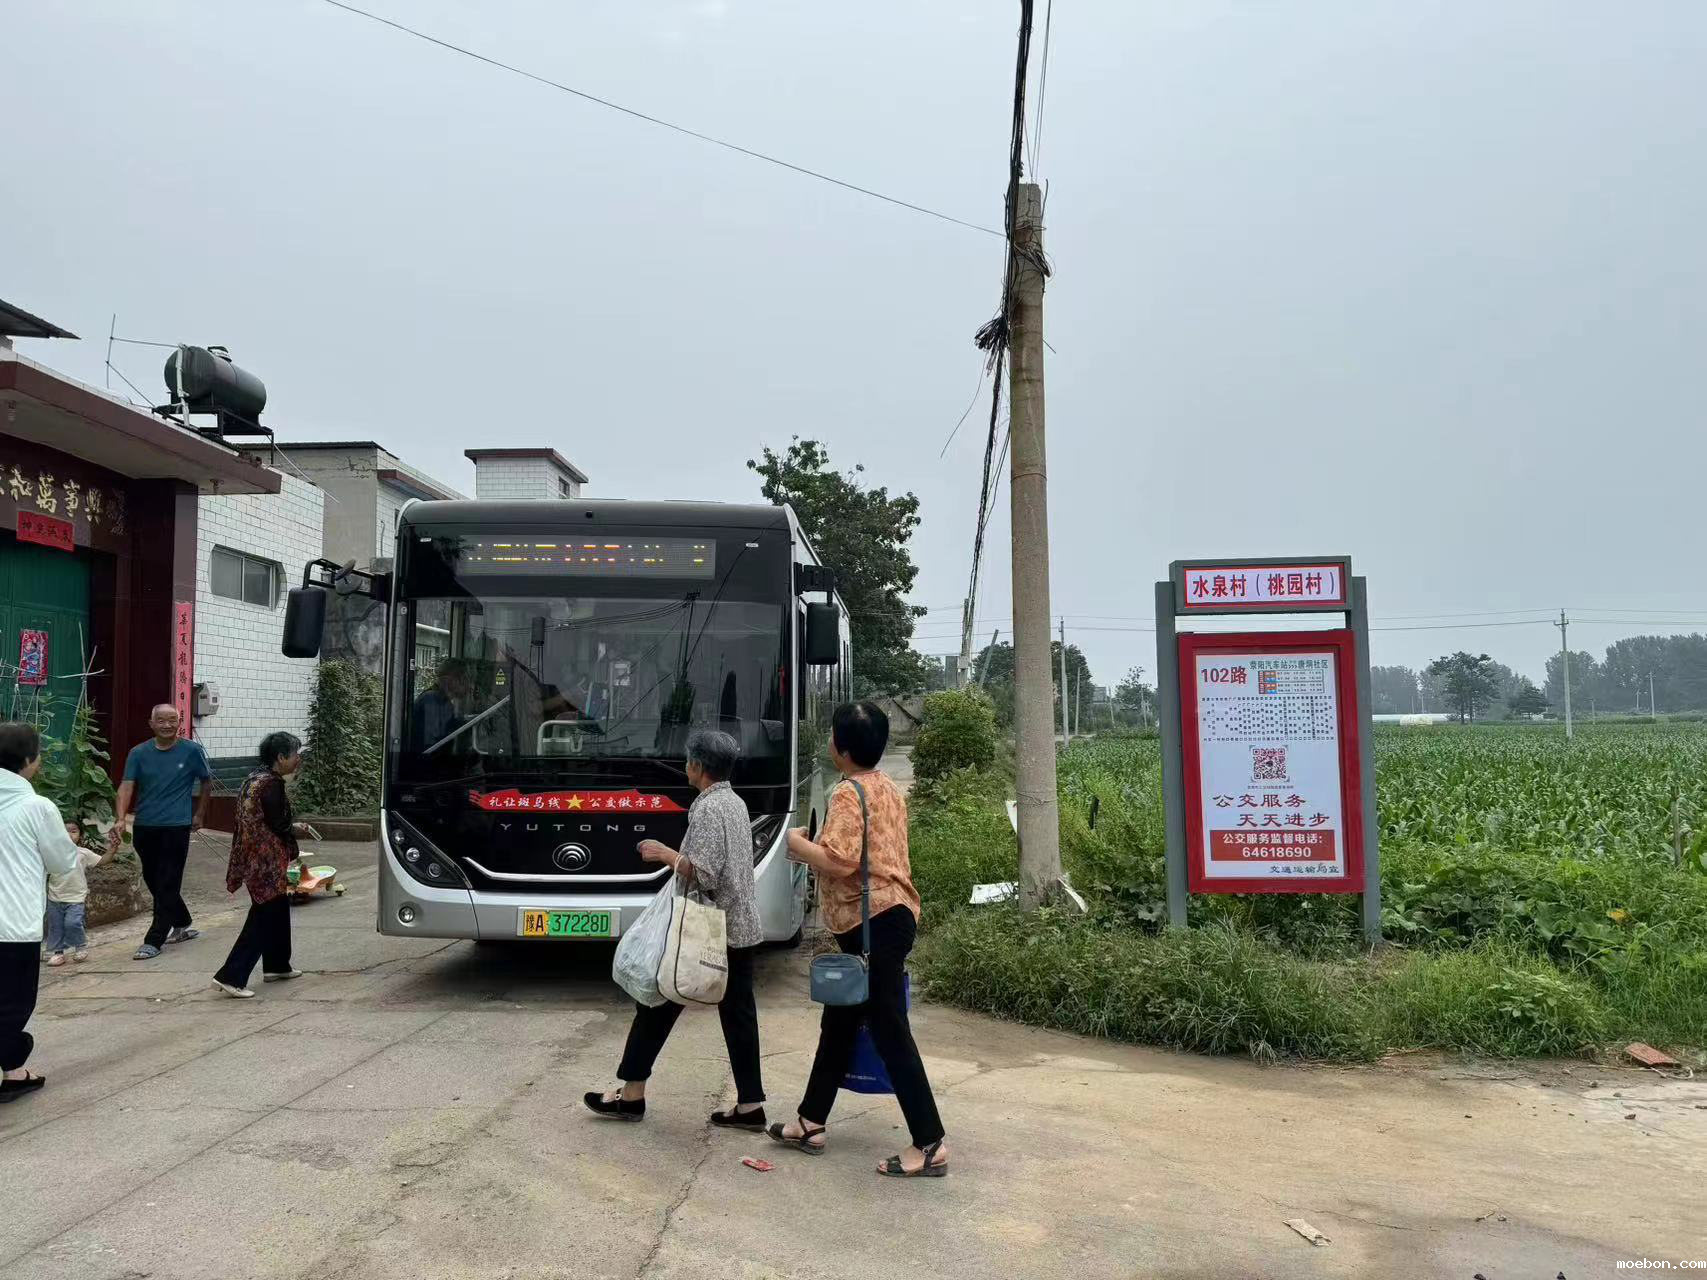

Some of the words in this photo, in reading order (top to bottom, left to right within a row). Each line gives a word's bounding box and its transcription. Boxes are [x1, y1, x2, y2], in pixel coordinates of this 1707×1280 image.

[1201, 666, 1247, 684] 102路
[489, 796, 561, 809] 礼让斑马线
[589, 796, 663, 809] 公交做示范
[1212, 794, 1306, 808] 公交服务
[1236, 813, 1330, 828] 天天进步
[500, 823, 647, 832] YUTONG
[1243, 847, 1311, 858] 64618690
[1269, 862, 1340, 874] 交通运输局宣
[525, 914, 544, 932] 豫A
[552, 914, 608, 932] 37228D
